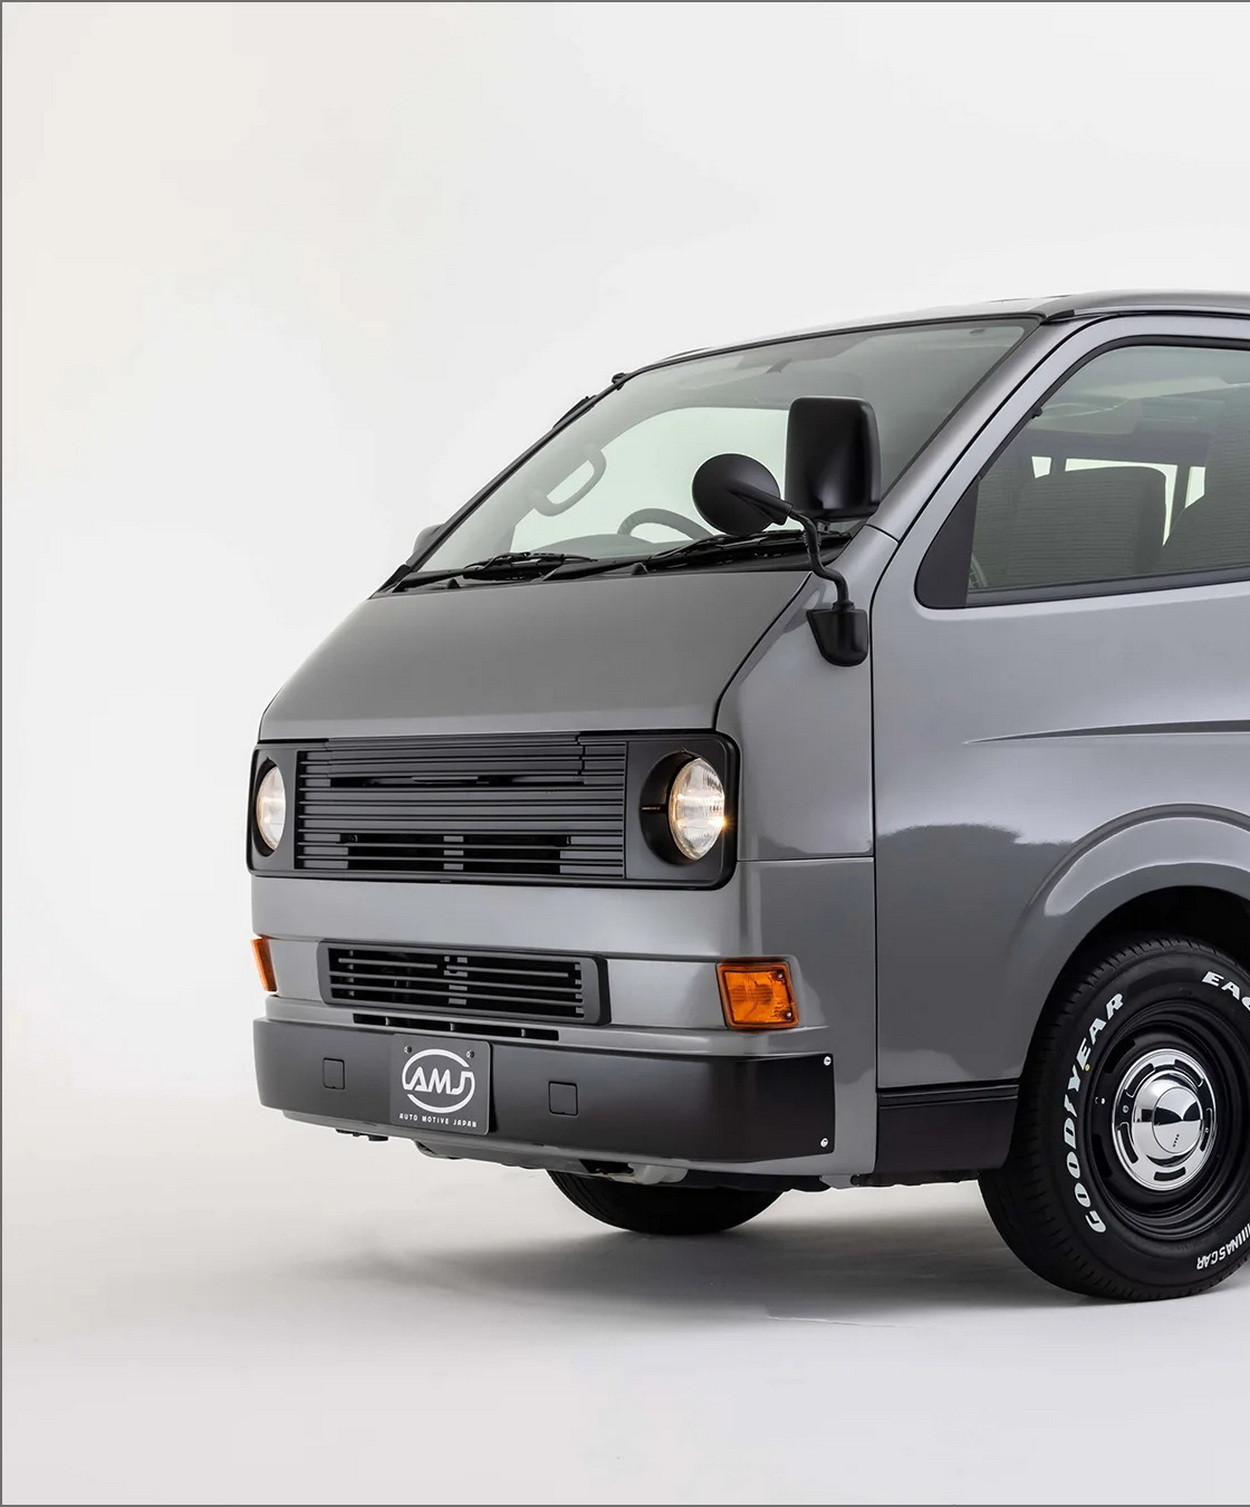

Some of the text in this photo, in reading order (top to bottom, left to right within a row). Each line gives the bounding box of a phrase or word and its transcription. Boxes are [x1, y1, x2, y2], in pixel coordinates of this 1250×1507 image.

[399, 1113, 477, 1128] AUTO MOTIVE JAPAN
[1064, 993, 1123, 1233] GOODYEAR
